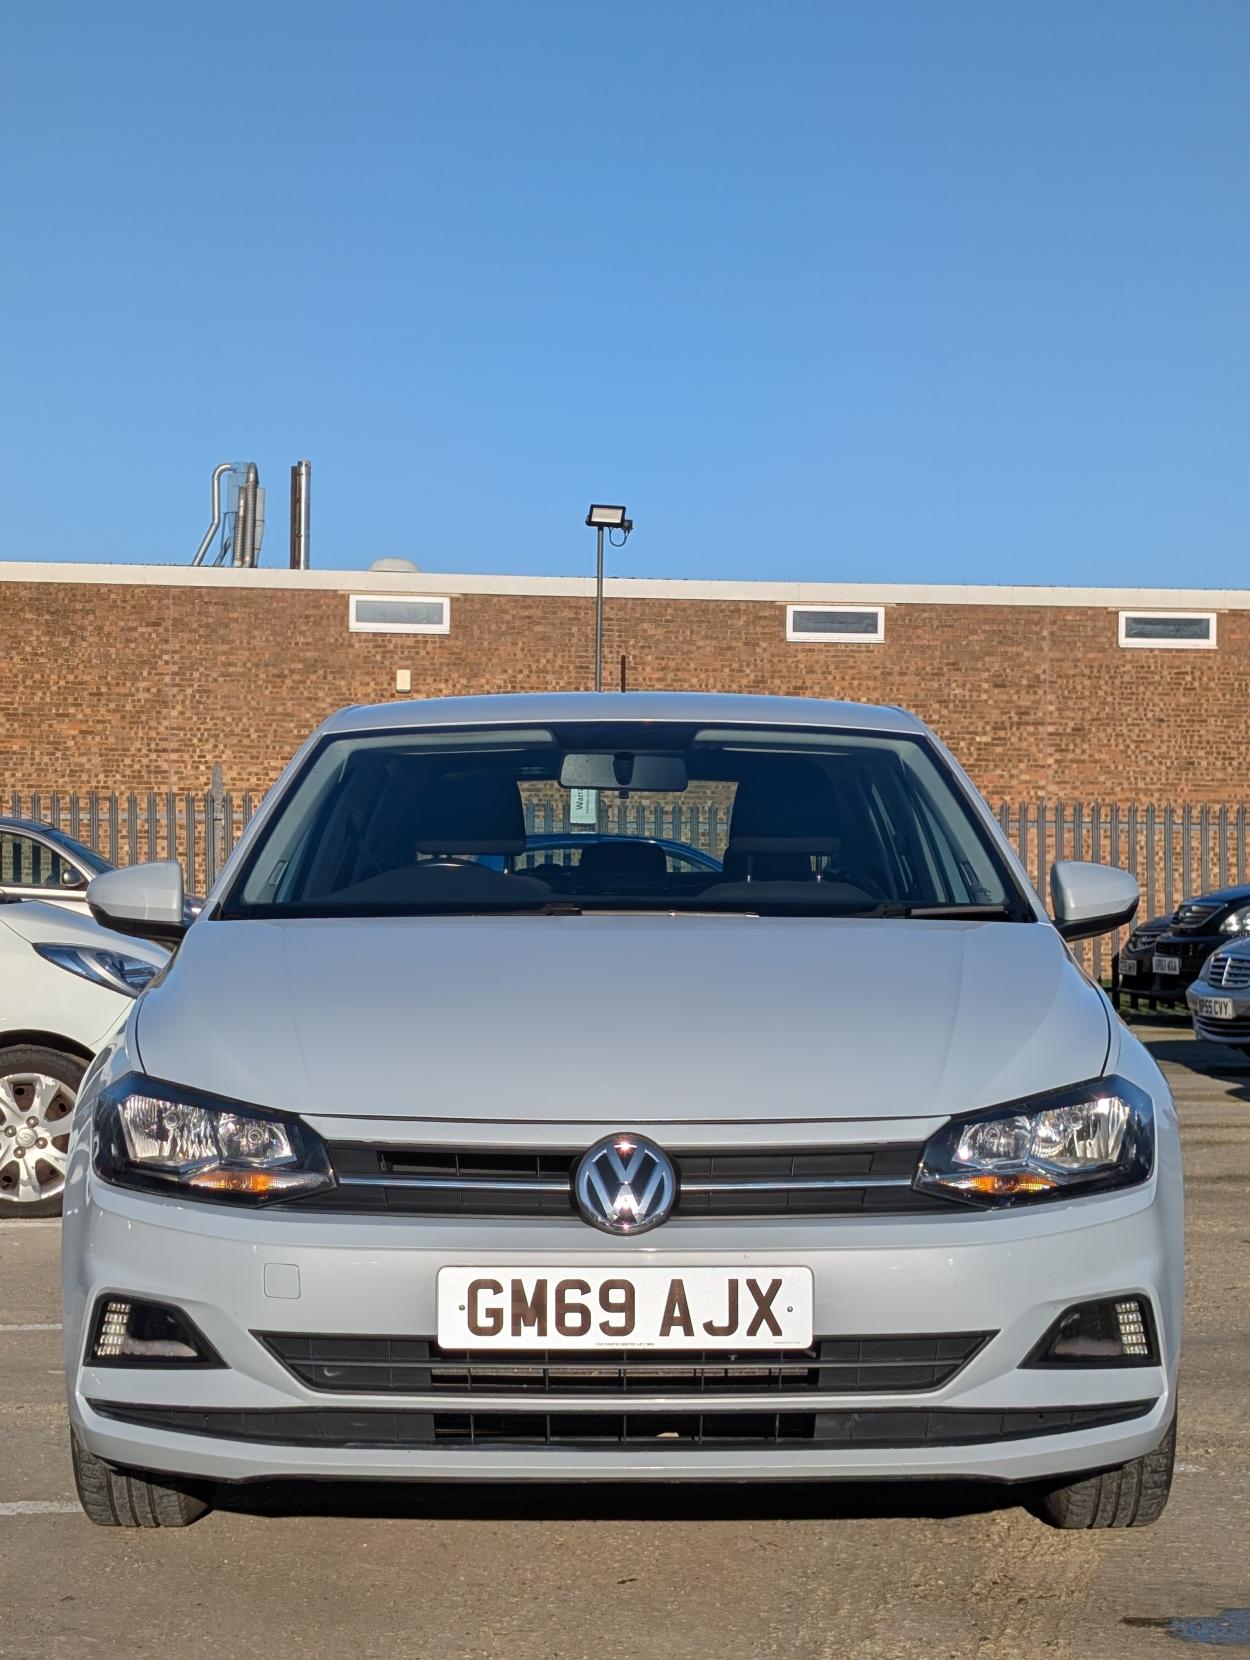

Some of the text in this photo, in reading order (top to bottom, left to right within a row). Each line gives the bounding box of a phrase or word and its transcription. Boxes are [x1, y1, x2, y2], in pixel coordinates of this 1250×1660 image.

[1214, 999, 1229, 1016] CVY
[467, 1278, 783, 1337] GM69 AJX
